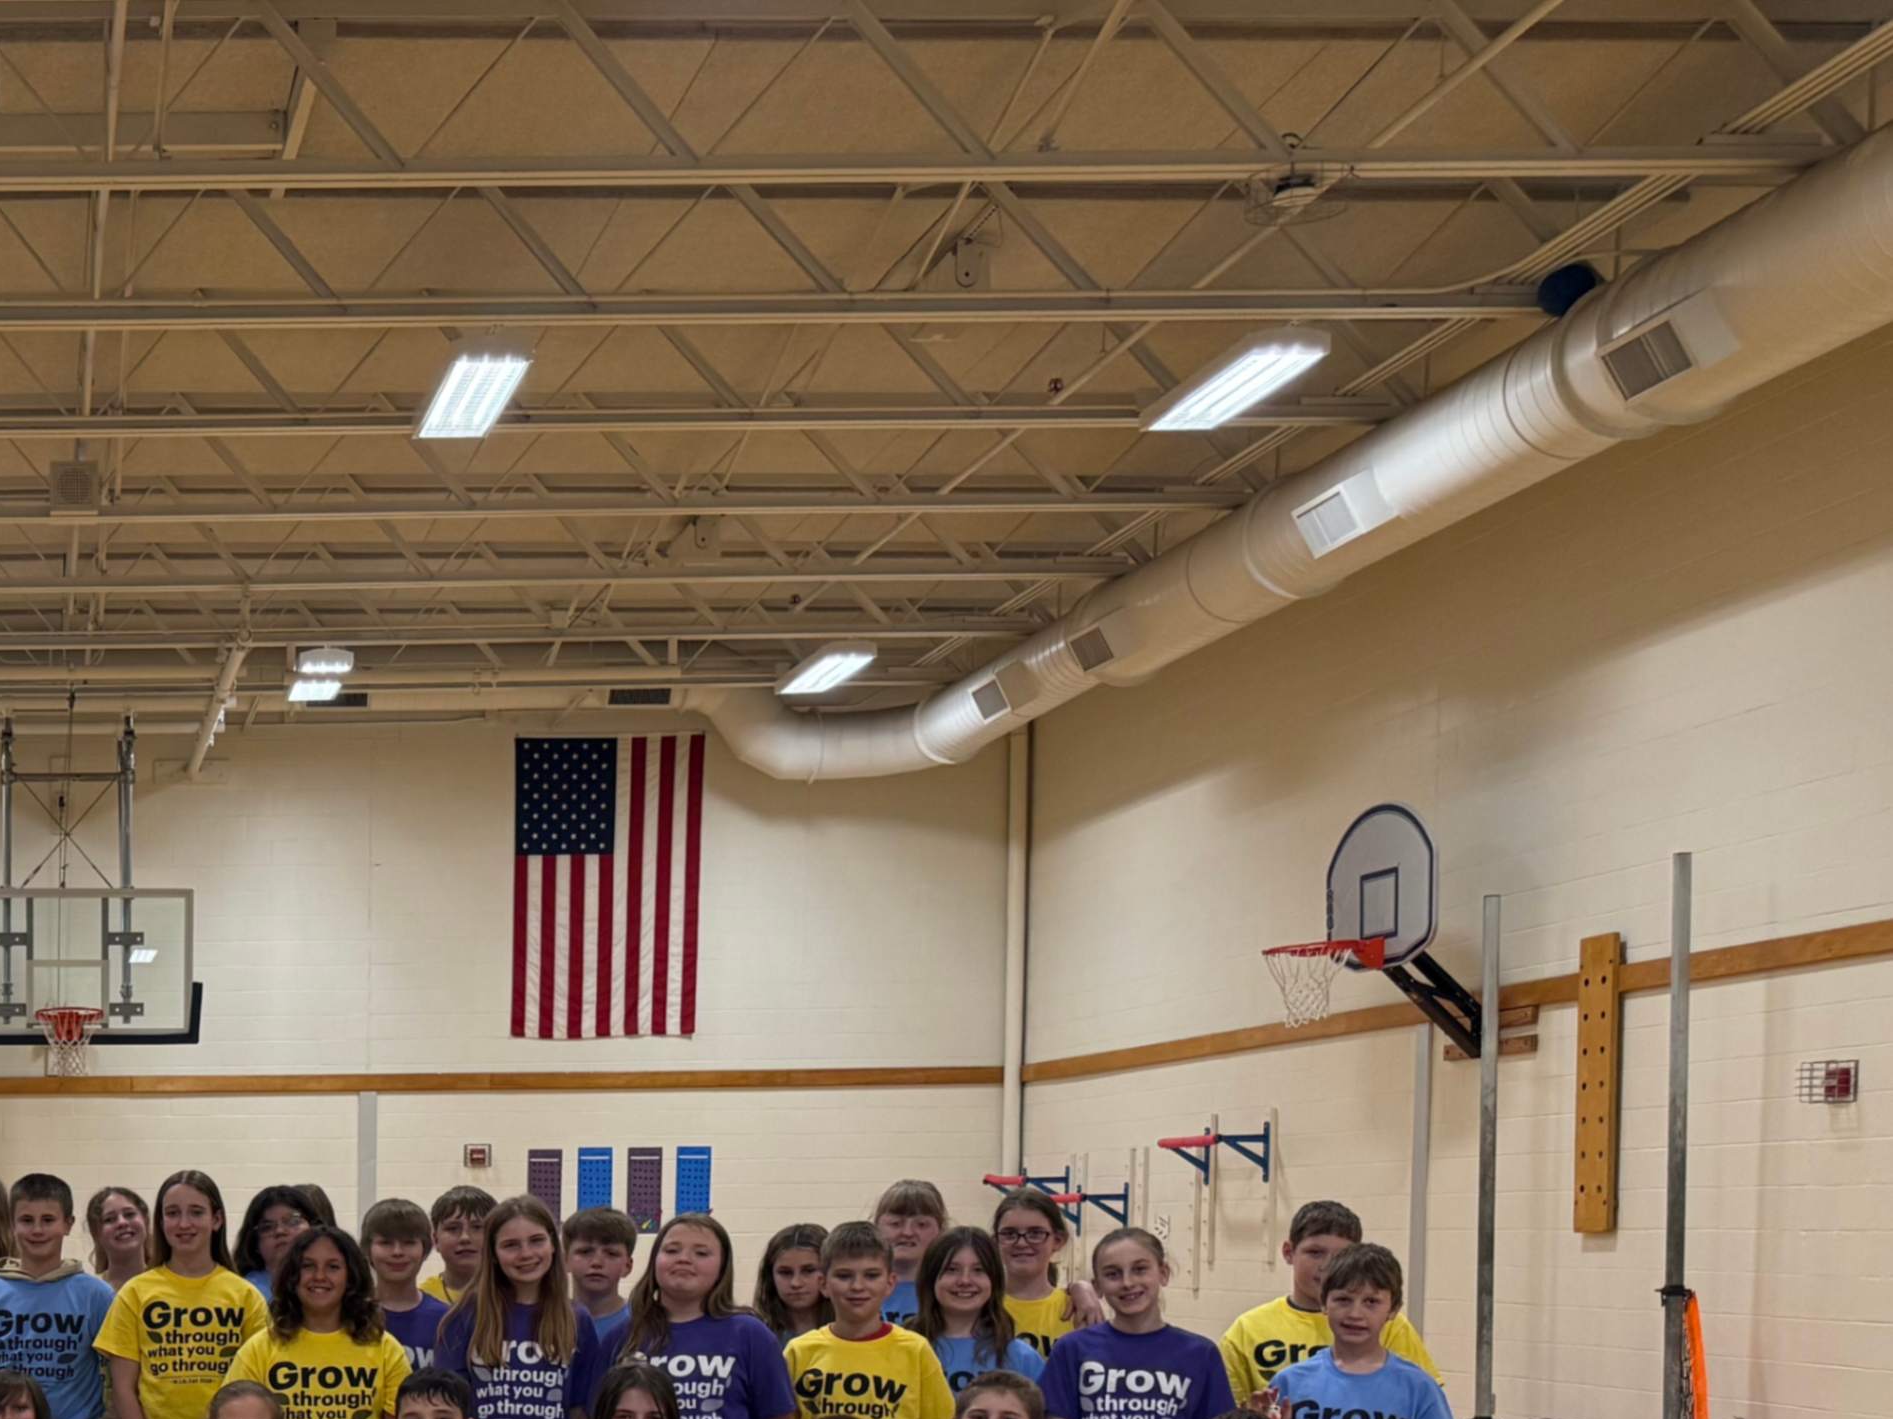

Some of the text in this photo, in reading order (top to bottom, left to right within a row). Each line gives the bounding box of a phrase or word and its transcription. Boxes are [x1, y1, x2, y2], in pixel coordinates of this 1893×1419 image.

[143, 1301, 244, 1329] Grow
[7, 1337, 77, 1352] through
[165, 1329, 240, 1345] through
[27, 1351, 54, 1364] you
[148, 1344, 215, 1359] what you
[1254, 1340, 1330, 1369] Gro
[150, 1362, 169, 1376] go
[267, 1361, 377, 1391] Grow
[493, 1367, 564, 1387] through
[796, 1368, 907, 1403] Grow
[1079, 1361, 1191, 1398] Grow
[292, 1391, 372, 1408] through
[476, 1385, 543, 1399] what you
[478, 1400, 564, 1419] go through
[1096, 1394, 1179, 1415] through
